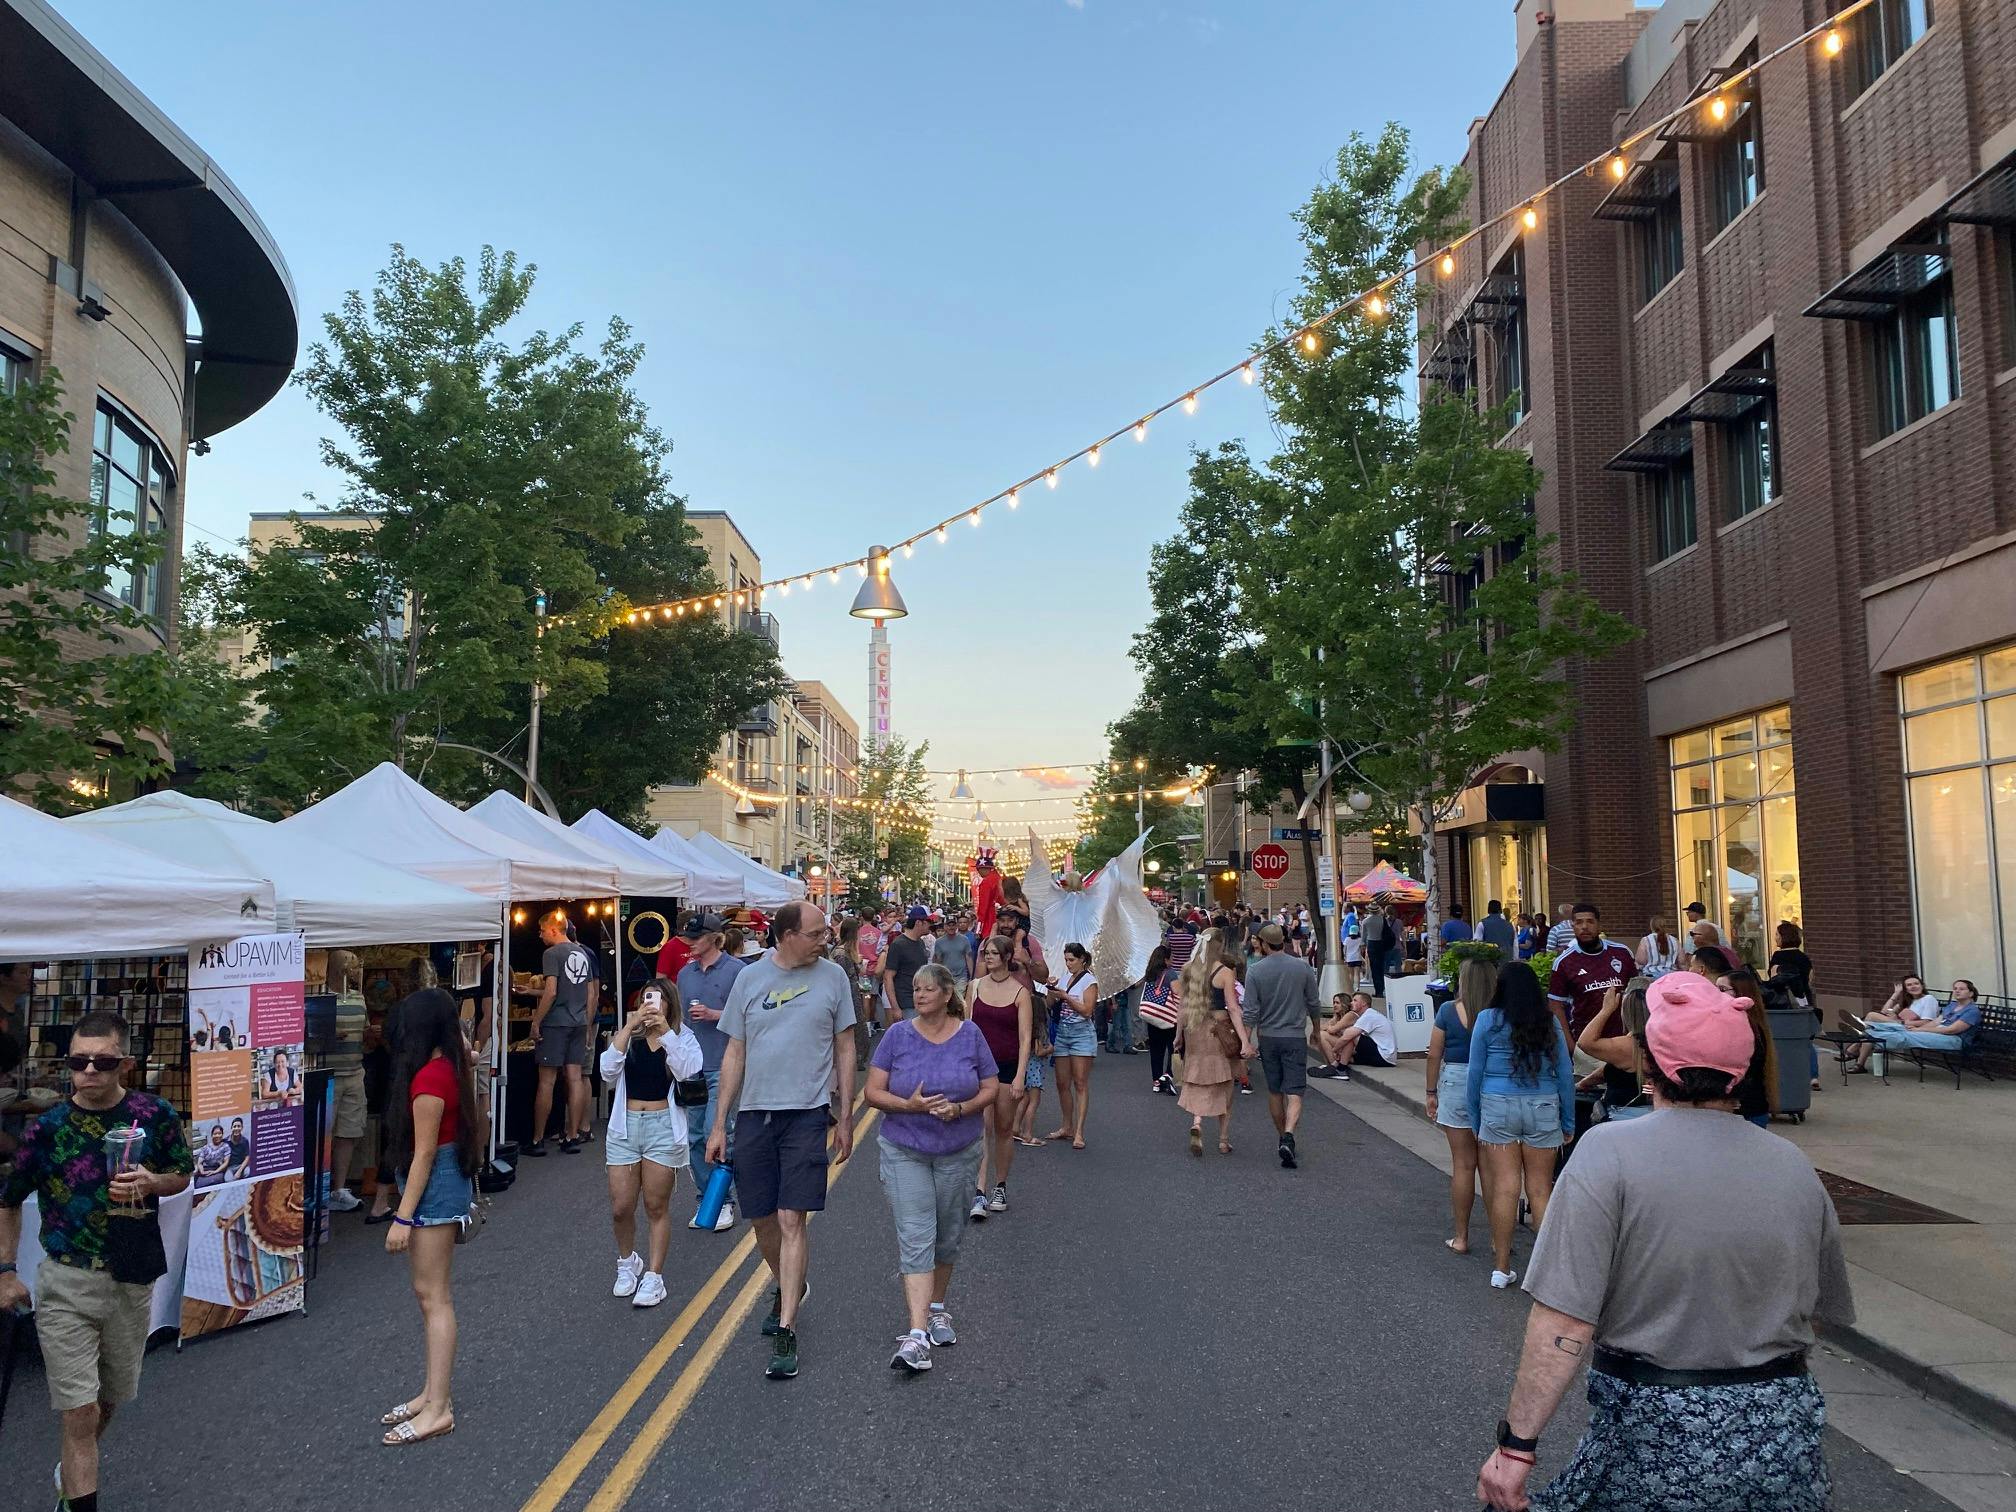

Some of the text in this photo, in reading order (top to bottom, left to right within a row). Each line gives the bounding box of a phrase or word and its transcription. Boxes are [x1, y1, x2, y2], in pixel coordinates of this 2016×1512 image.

[1254, 854, 1288, 869] STOP
[225, 940, 293, 968] UPAVIM
[293, 939, 303, 965] crafts
[1584, 976, 1622, 991] uchealth
